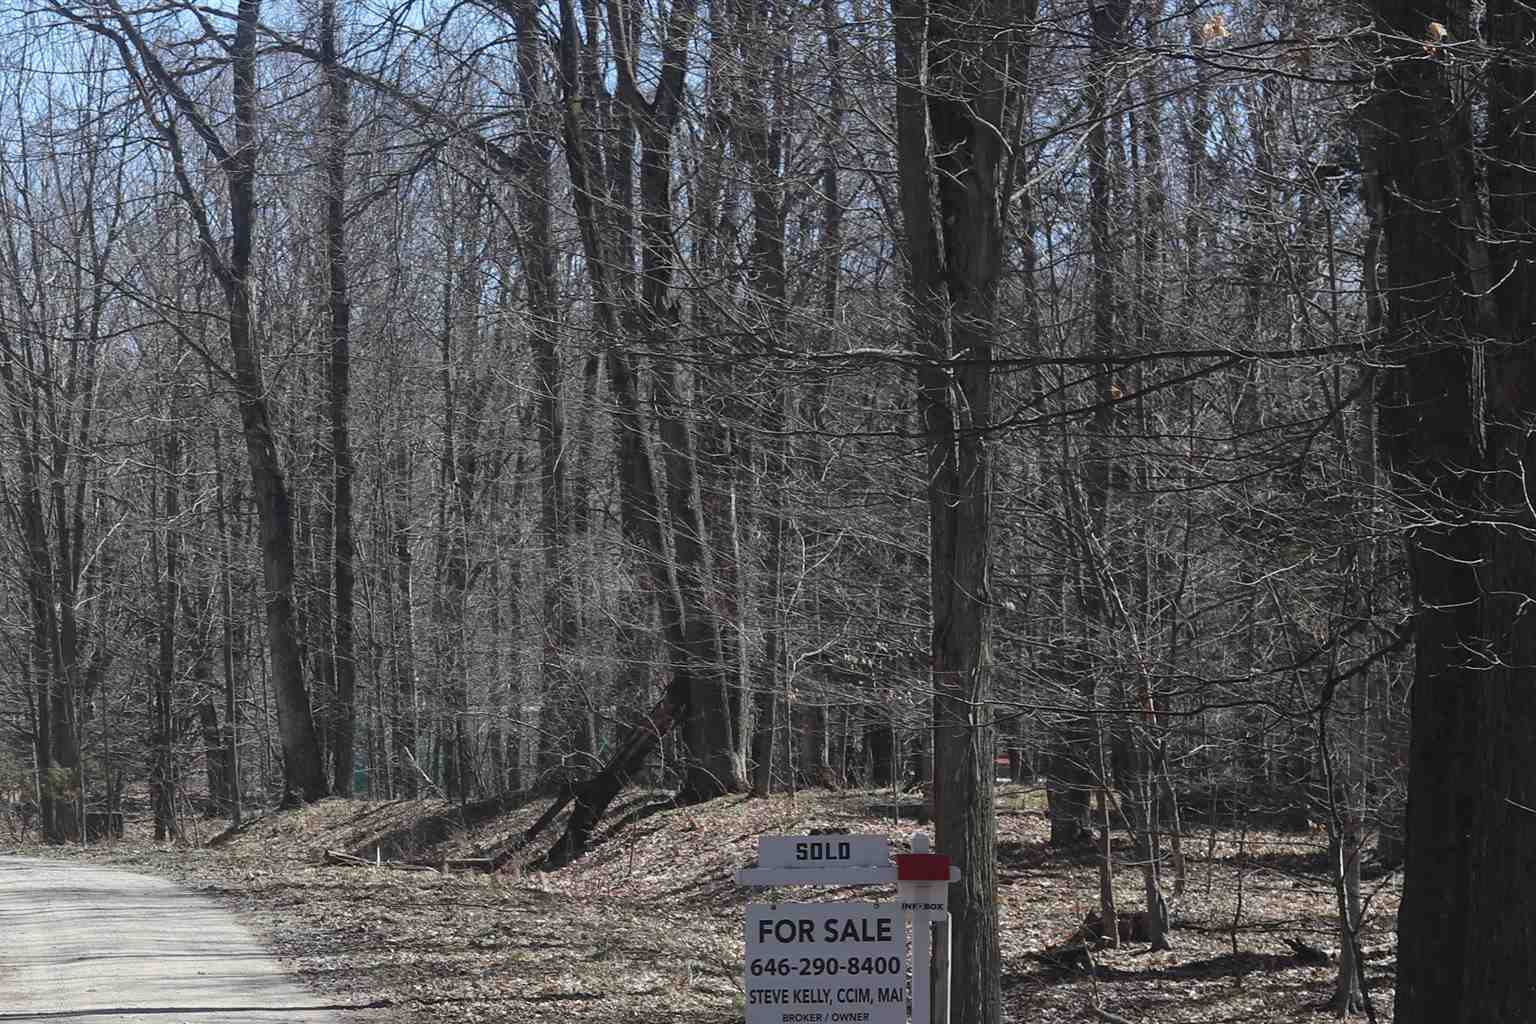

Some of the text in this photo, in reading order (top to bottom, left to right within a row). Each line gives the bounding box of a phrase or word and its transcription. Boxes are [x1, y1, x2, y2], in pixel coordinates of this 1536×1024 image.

[796, 842, 851, 861] SOLD
[759, 918, 892, 943] FOR SALE
[750, 957, 901, 976] 646-290-8400
[750, 988, 904, 1006] STEVE KELLY, CCIM, MAI
[782, 1013, 822, 1022] BROKER
[831, 1012, 869, 1022] OWNER
